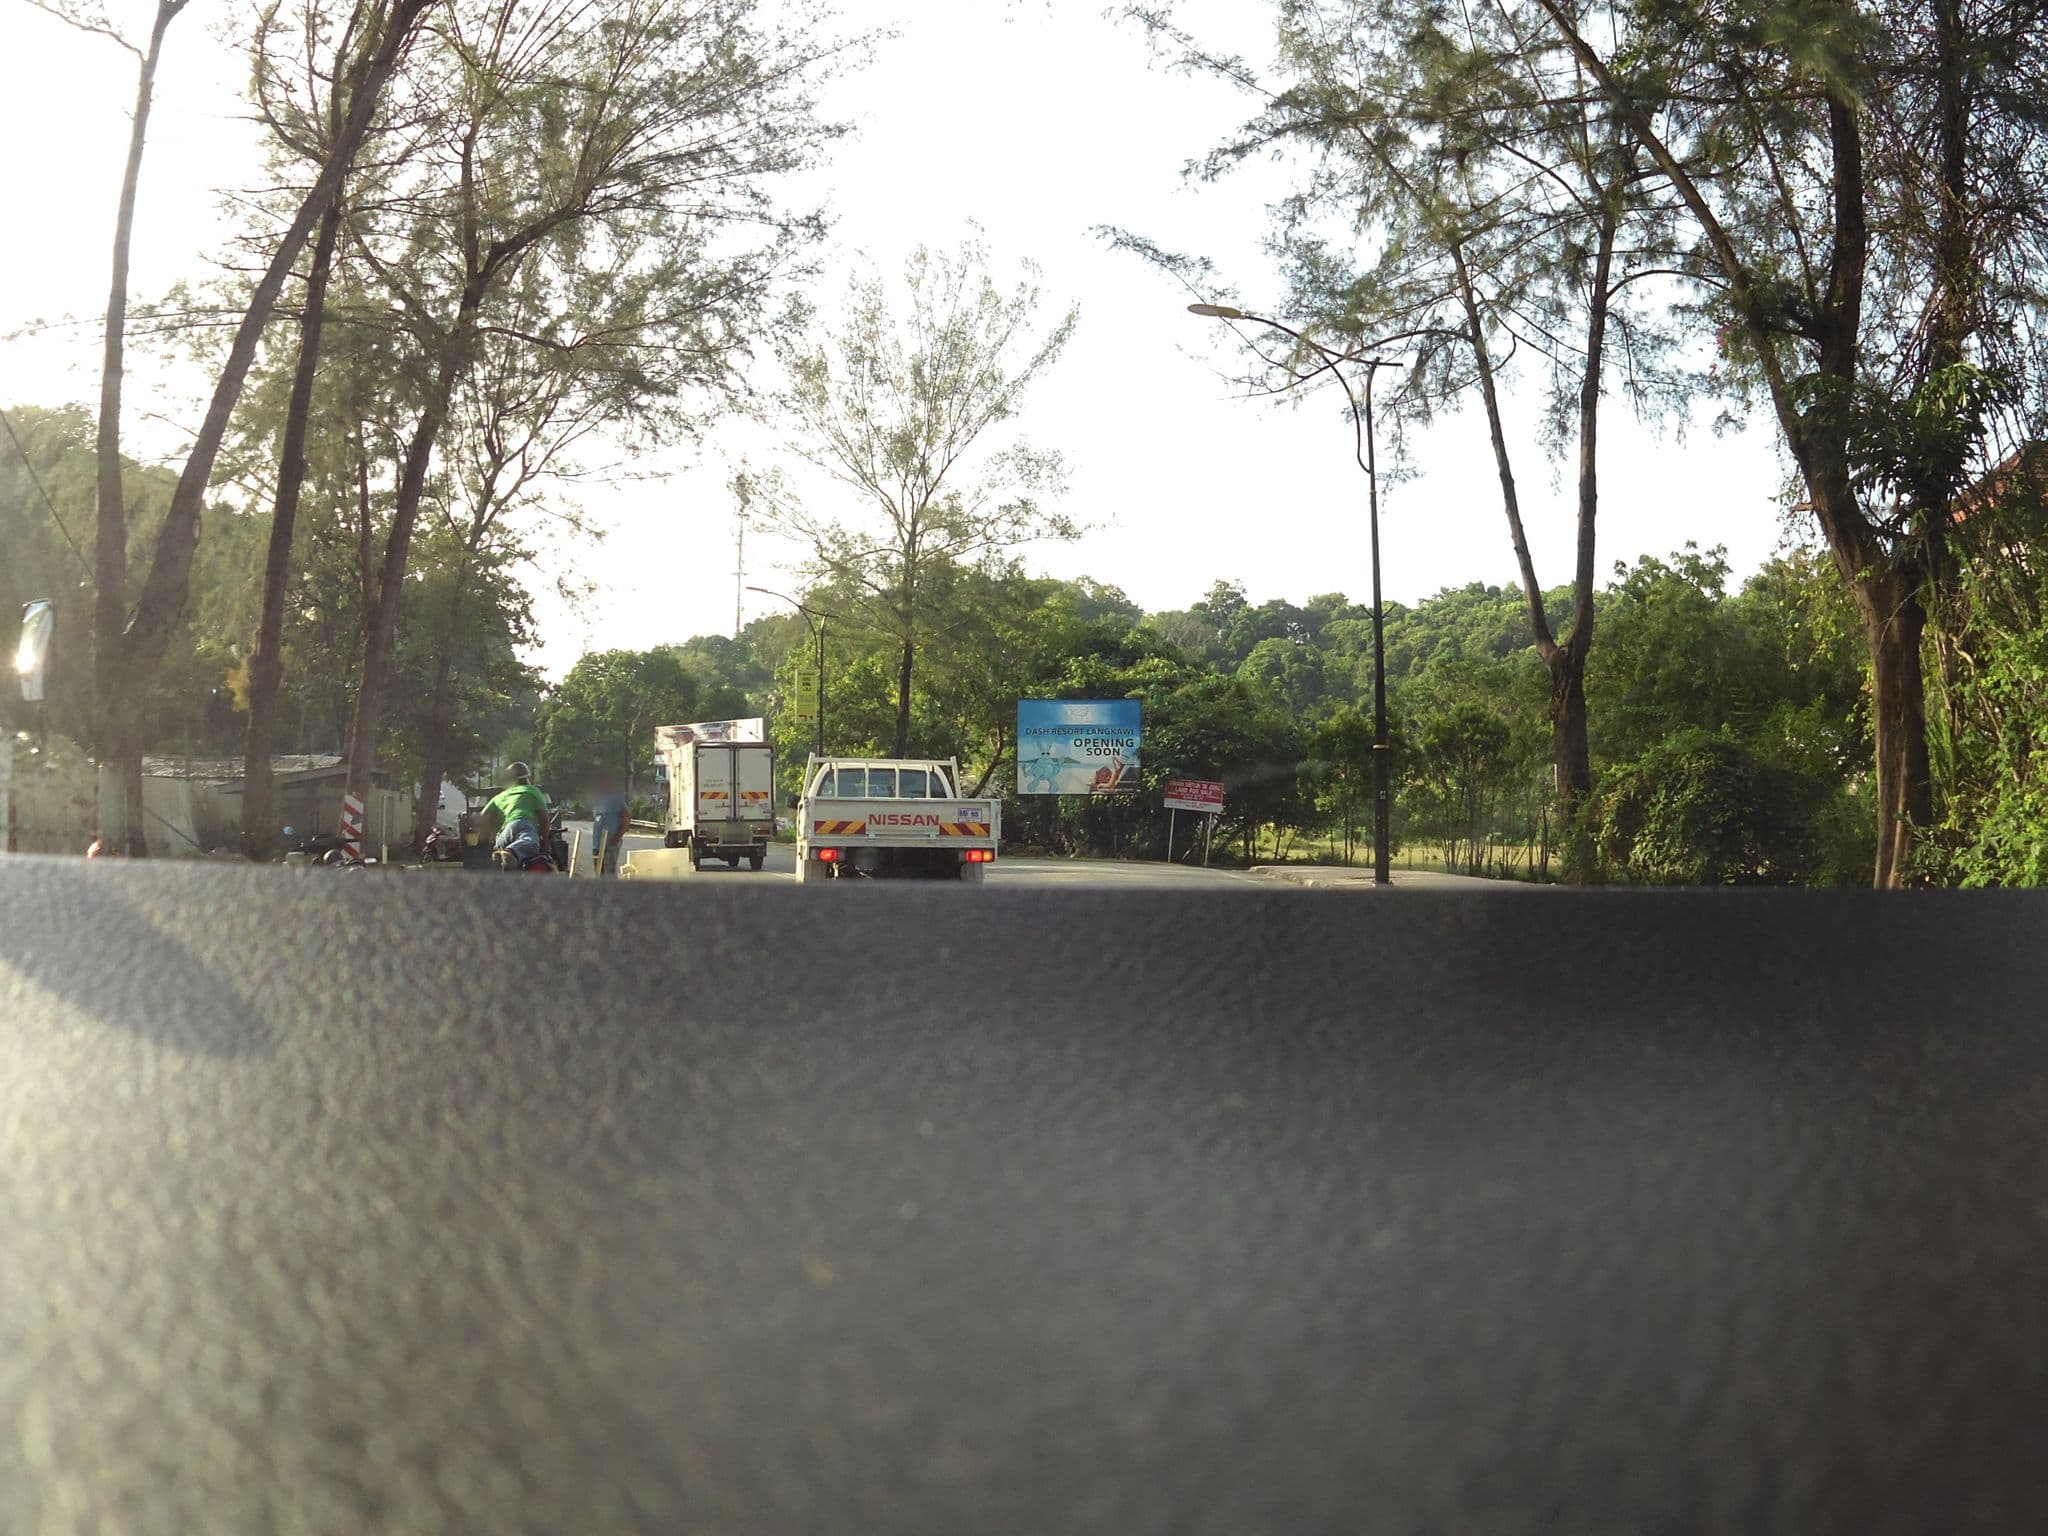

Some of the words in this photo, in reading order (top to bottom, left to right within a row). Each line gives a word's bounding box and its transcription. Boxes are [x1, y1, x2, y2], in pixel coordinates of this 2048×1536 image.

[1025, 727, 1050, 736] DASH
[1052, 727, 1084, 736] RESORT
[1086, 727, 1134, 736] LANGKAWI
[1073, 738, 1135, 748] OPENING
[1086, 747, 1121, 757] SOON
[868, 814, 939, 826] NISSAN
